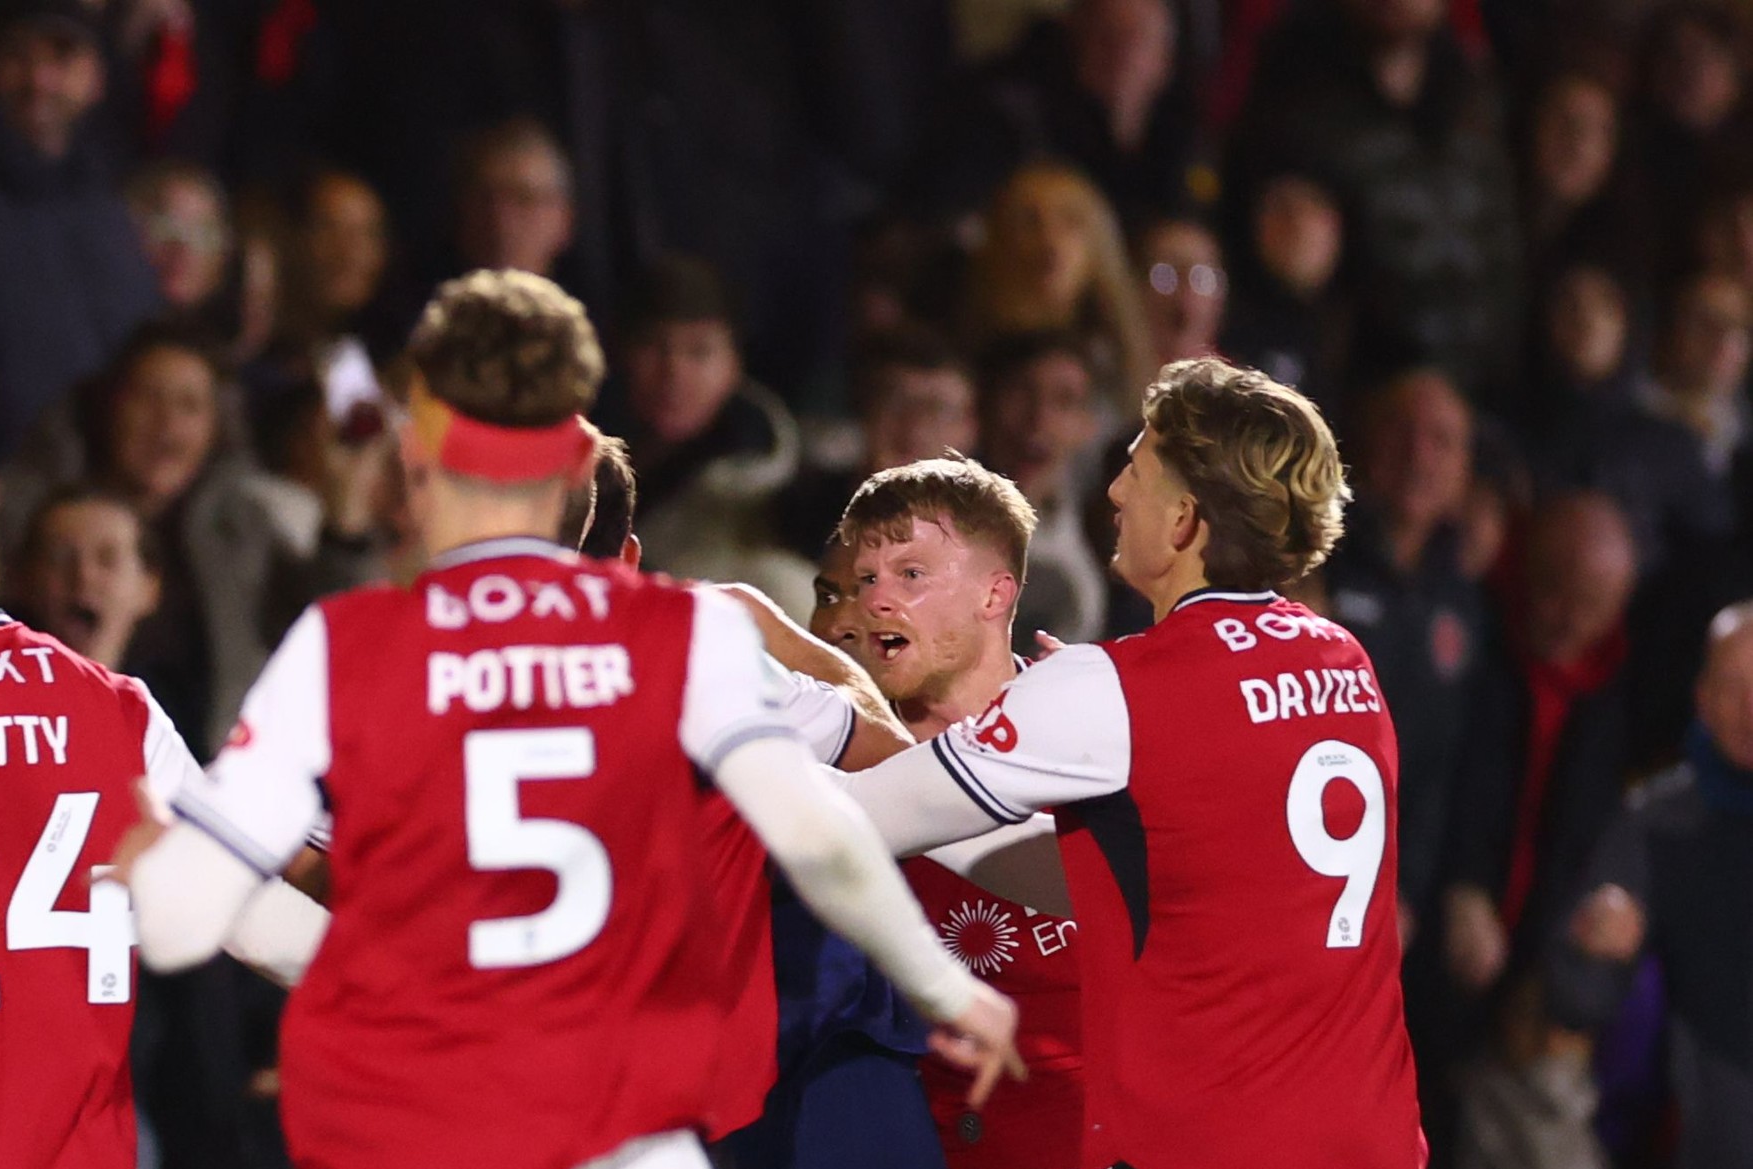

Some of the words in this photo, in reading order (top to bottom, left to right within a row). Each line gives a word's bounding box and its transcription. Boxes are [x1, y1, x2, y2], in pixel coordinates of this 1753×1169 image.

[426, 642, 637, 716] POTTER
[1239, 668, 1382, 724] DAVIES
[463, 725, 614, 970] 5
[1286, 738, 1387, 949] 9
